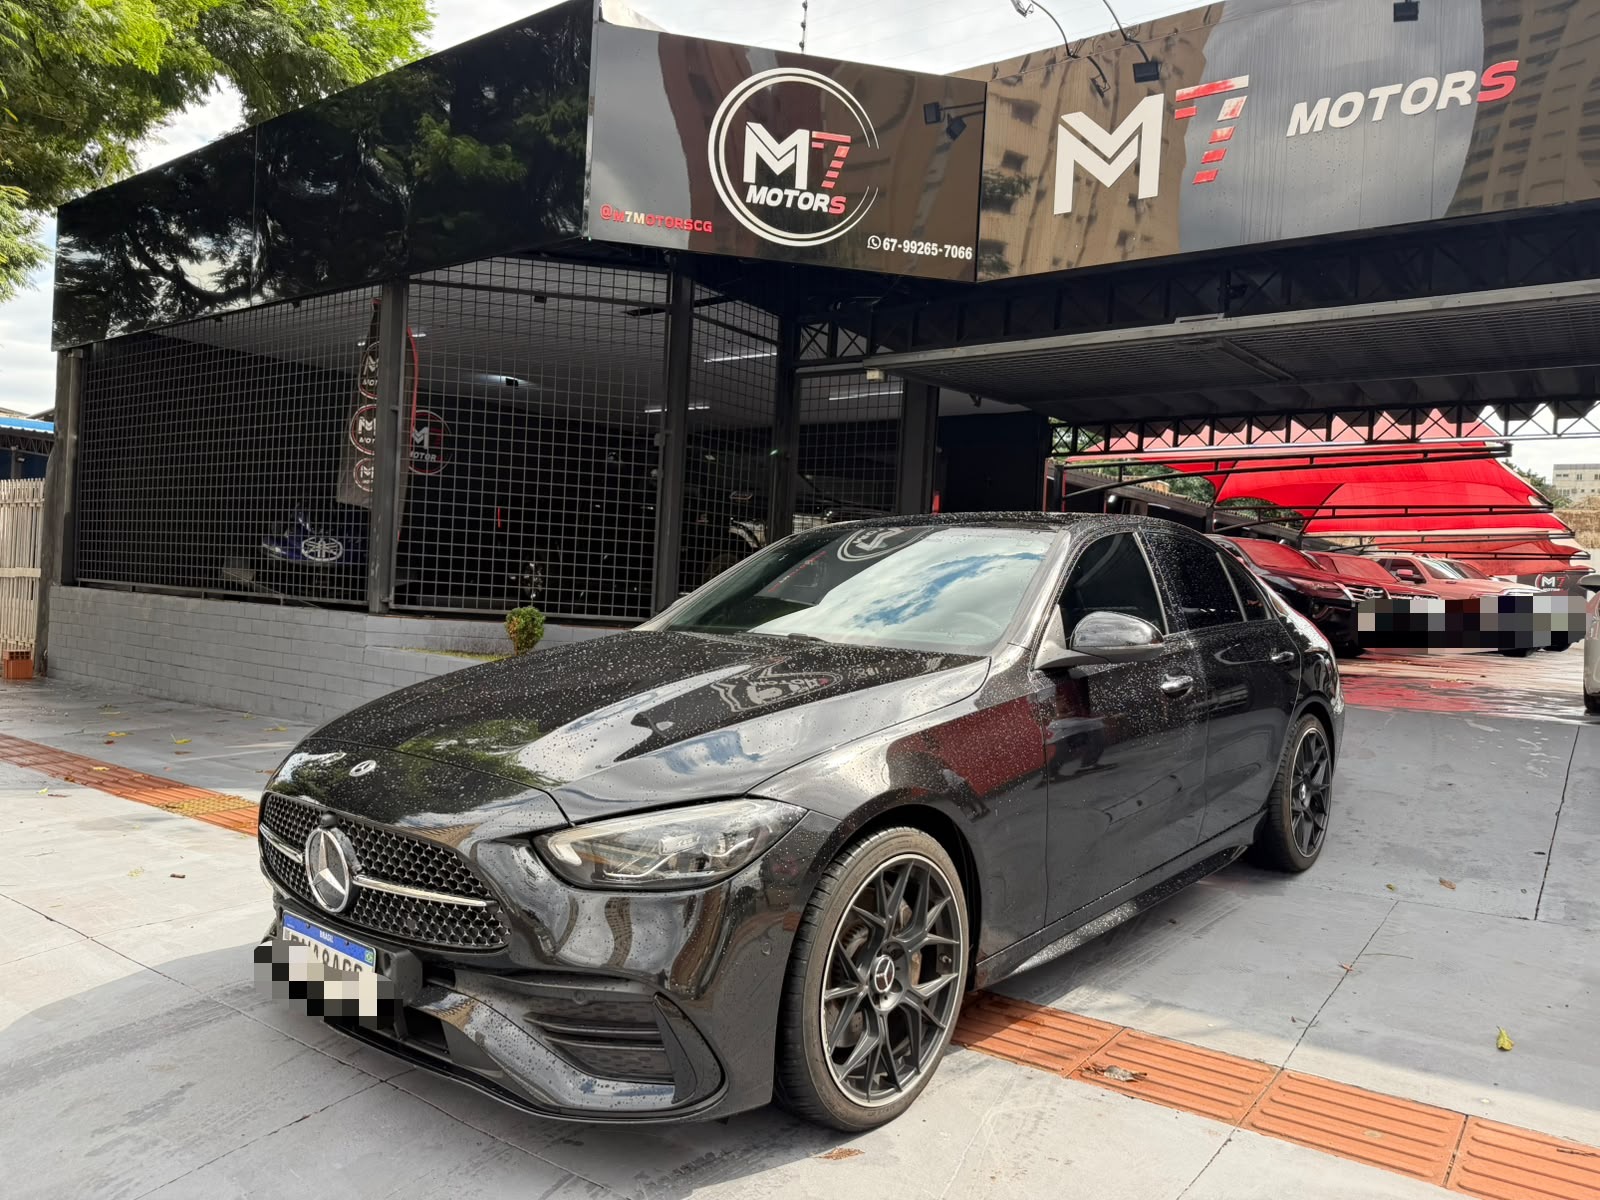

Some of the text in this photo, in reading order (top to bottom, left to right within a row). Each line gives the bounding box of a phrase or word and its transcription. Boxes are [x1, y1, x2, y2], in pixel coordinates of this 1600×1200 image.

[1053, 60, 1519, 215] M7 MOTORS
[743, 121, 852, 190] M7
[745, 184, 847, 215] MOTORS
[600, 203, 713, 233] @M7MOTORSCG
[882, 237, 973, 260] 67-99265-7066
[1541, 576, 1565, 588] M7
